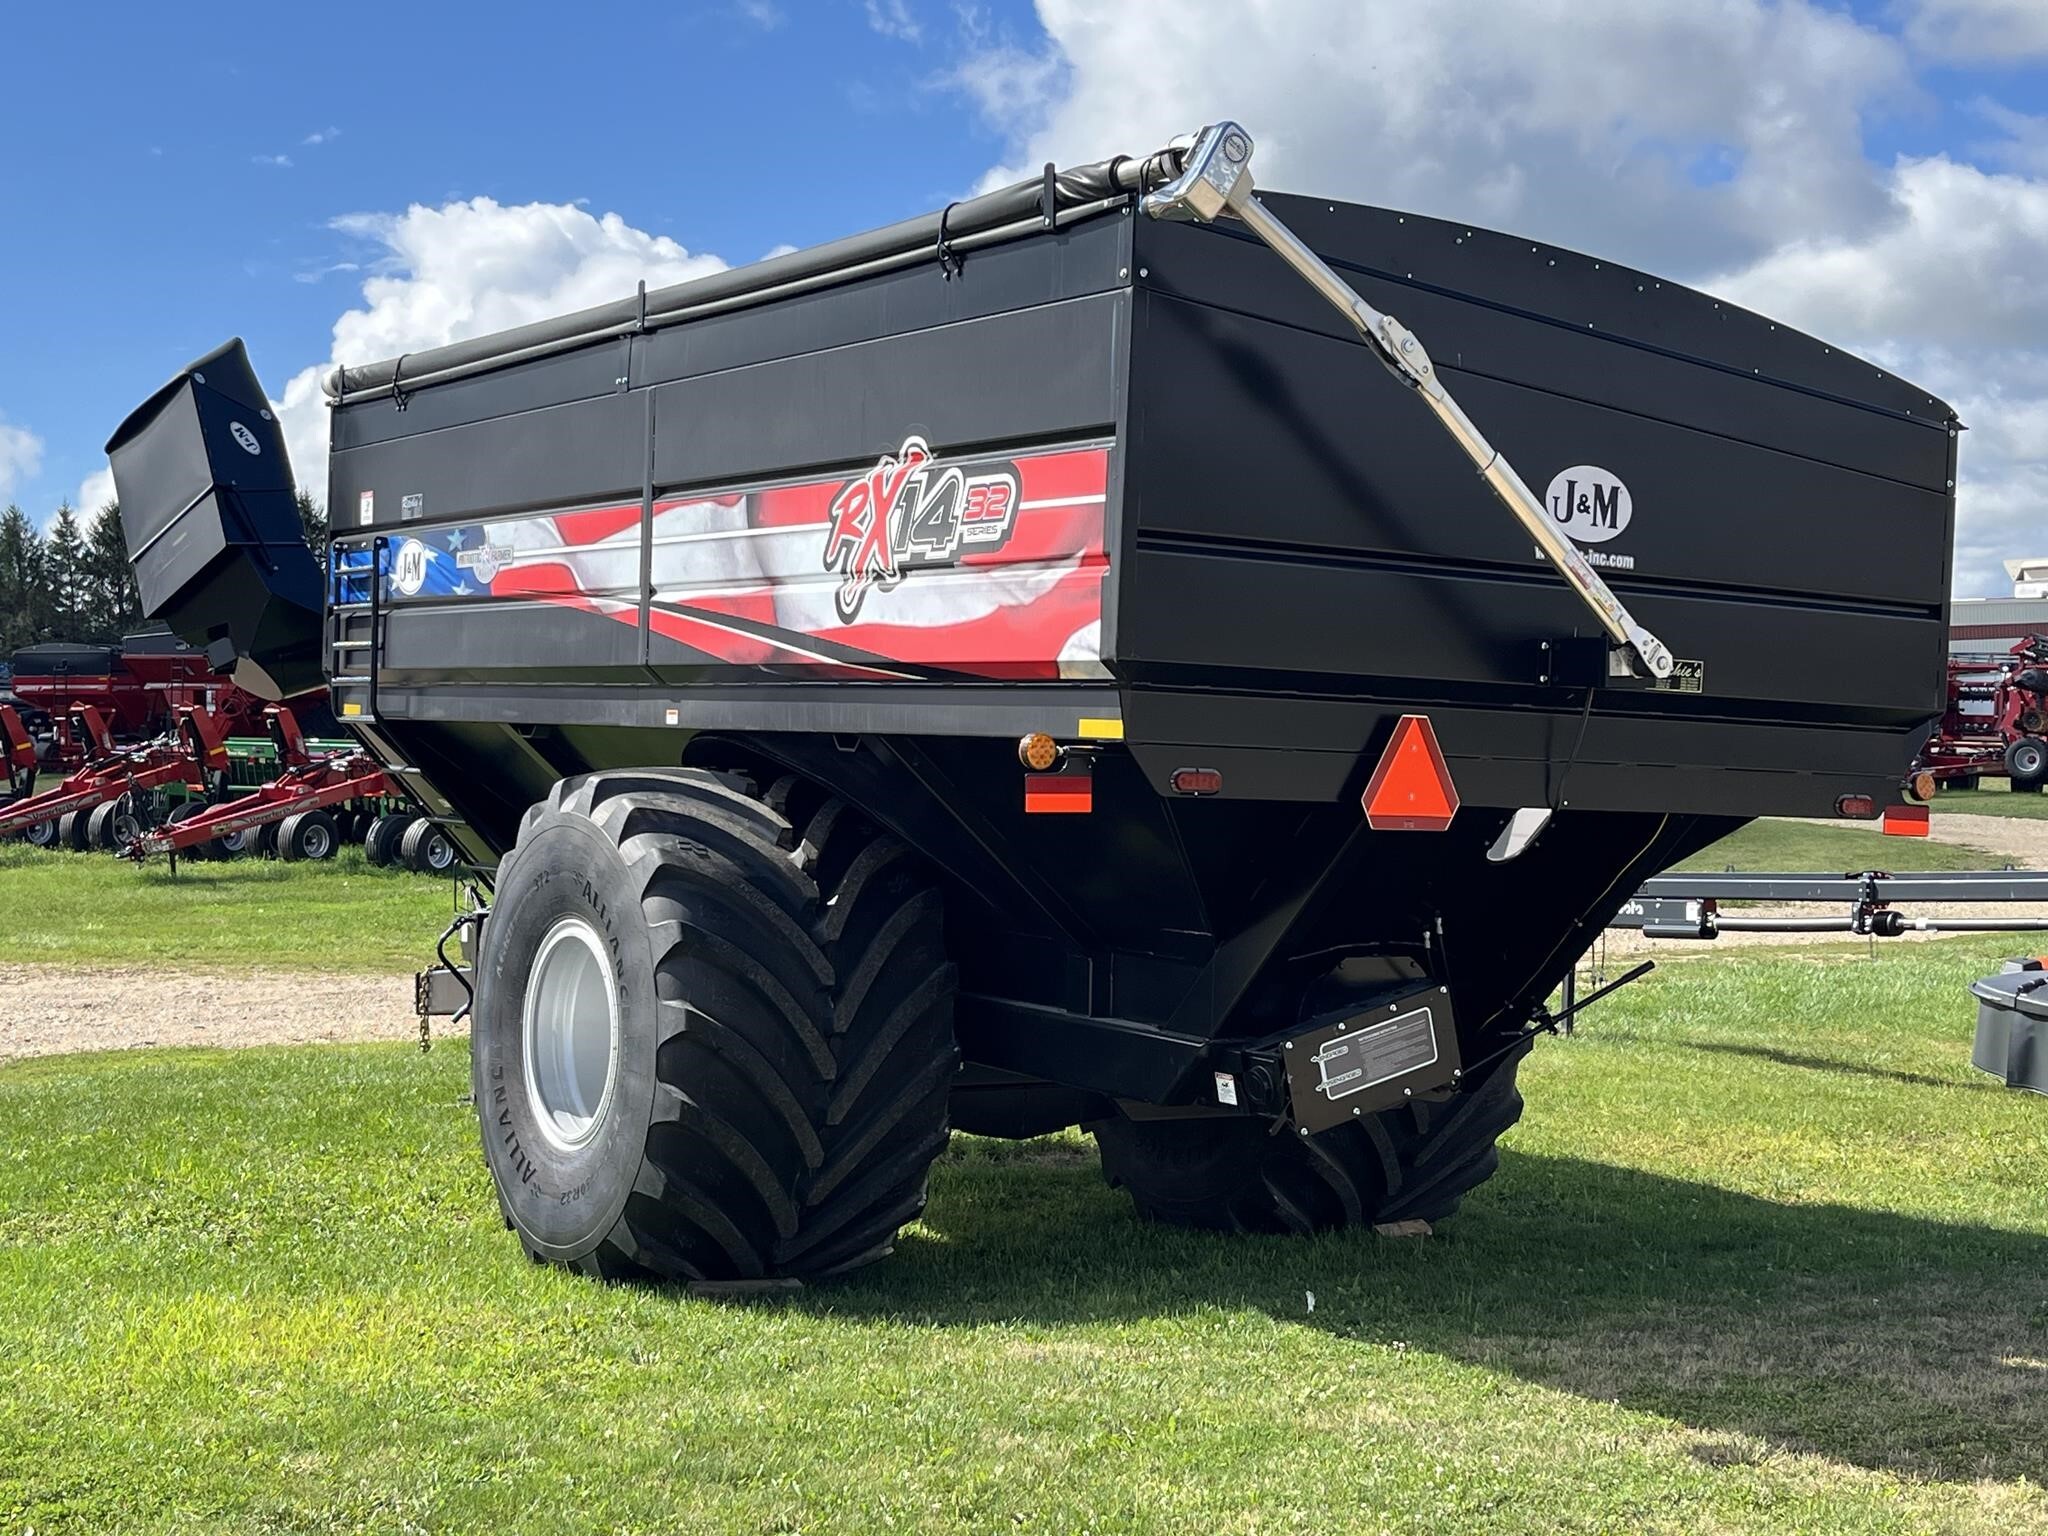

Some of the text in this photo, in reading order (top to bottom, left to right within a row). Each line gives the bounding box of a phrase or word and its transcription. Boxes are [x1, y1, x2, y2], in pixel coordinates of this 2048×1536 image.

[963, 486, 1010, 521] 32
[1552, 479, 1621, 530] J&M
[967, 525, 998, 536] SERIES
[401, 552, 422, 583] J&M
